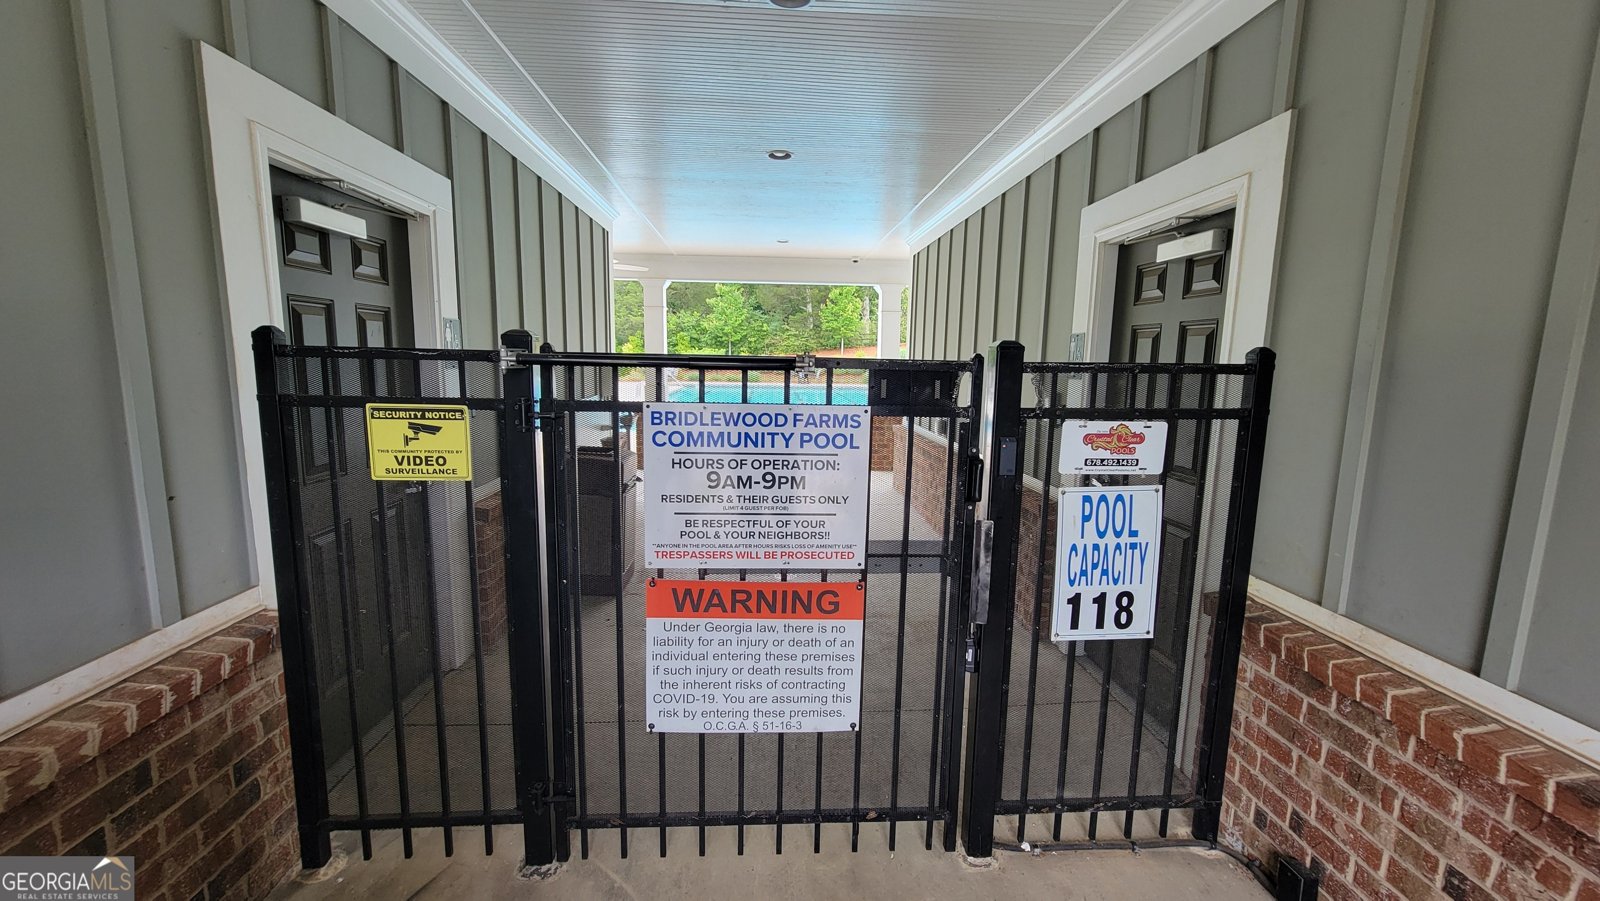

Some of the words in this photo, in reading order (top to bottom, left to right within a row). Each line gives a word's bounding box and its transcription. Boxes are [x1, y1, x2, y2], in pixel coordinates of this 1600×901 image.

[373, 410, 422, 419] SECURITY
[650, 411, 788, 428] BRIDLEWOOD
[793, 413, 862, 429] FARMS
[651, 430, 795, 448] COMMUNITY
[800, 432, 860, 449] POOL
[394, 455, 447, 466] VIDEO
[671, 458, 725, 470] HOURS
[727, 459, 748, 470] OF
[751, 459, 840, 471] OPERATION:
[706, 471, 806, 490] 9AM-9PM
[661, 494, 724, 504] RESIDENTS
[726, 495, 734, 504] &
[736, 494, 769, 504] THEIR
[771, 495, 816, 504] GUESTS
[818, 496, 849, 504] ONLY
[1080, 493, 1139, 539] POOL
[684, 519, 699, 528] BE
[701, 519, 773, 528] RESPECTFUL
[775, 520, 791, 528] OF
[793, 520, 826, 528] YOUR
[680, 531, 711, 539] POOL
[713, 531, 721, 539] &
[723, 531, 756, 539] YOUR
[758, 531, 830, 540] NEIGHBORS!!
[654, 551, 733, 559] TRESPASSERS
[735, 551, 761, 559] WILL
[763, 551, 778, 559] BE
[780, 551, 855, 560] PROSECUTED
[1067, 541, 1149, 587] CAPACITY
[671, 587, 840, 615] WARNING
[1066, 590, 1135, 630] 118
[663, 621, 700, 632] Under
[704, 621, 752, 635] Georgia
[756, 622, 779, 634] law,
[783, 623, 814, 633] there
[817, 623, 827, 633] is
[831, 625, 846, 633] no
[653, 636, 694, 649] liability
[698, 636, 714, 647] for
[717, 638, 732, 647] an
[736, 636, 768, 649] injury
[772, 639, 784, 648] or
[788, 637, 821, 648] death
[825, 637, 837, 648] of
[840, 639, 854, 648] an
[651, 651, 709, 661] individual
[712, 651, 760, 663] entering
[765, 651, 798, 661] these
[801, 651, 855, 663] premises
[652, 665, 660, 675] if
[663, 665, 692, 675] such
[696, 665, 728, 677] injury
[731, 667, 744, 675] or
[747, 665, 780, 675] death
[784, 666, 823, 676] results
[827, 666, 854, 676] from
[660, 680, 679, 690] the
[682, 679, 731, 690] inherent
[735, 680, 762, 690] risks
[766, 679, 778, 689] of
[781, 680, 846, 692] contracting
[653, 693, 718, 704] COVID-19.
[722, 693, 745, 704] You
[748, 695, 768, 704] are
[771, 693, 828, 705] assuming
[831, 694, 852, 704] this
[658, 708, 679, 718] risk
[683, 708, 697, 720] by
[701, 708, 749, 720] entering
[753, 708, 785, 718] these
[789, 708, 846, 720] premises.
[703, 721, 749, 731] O.C.G.A.
[752, 721, 759, 733] §
[762, 721, 802, 731] 51-16-3
